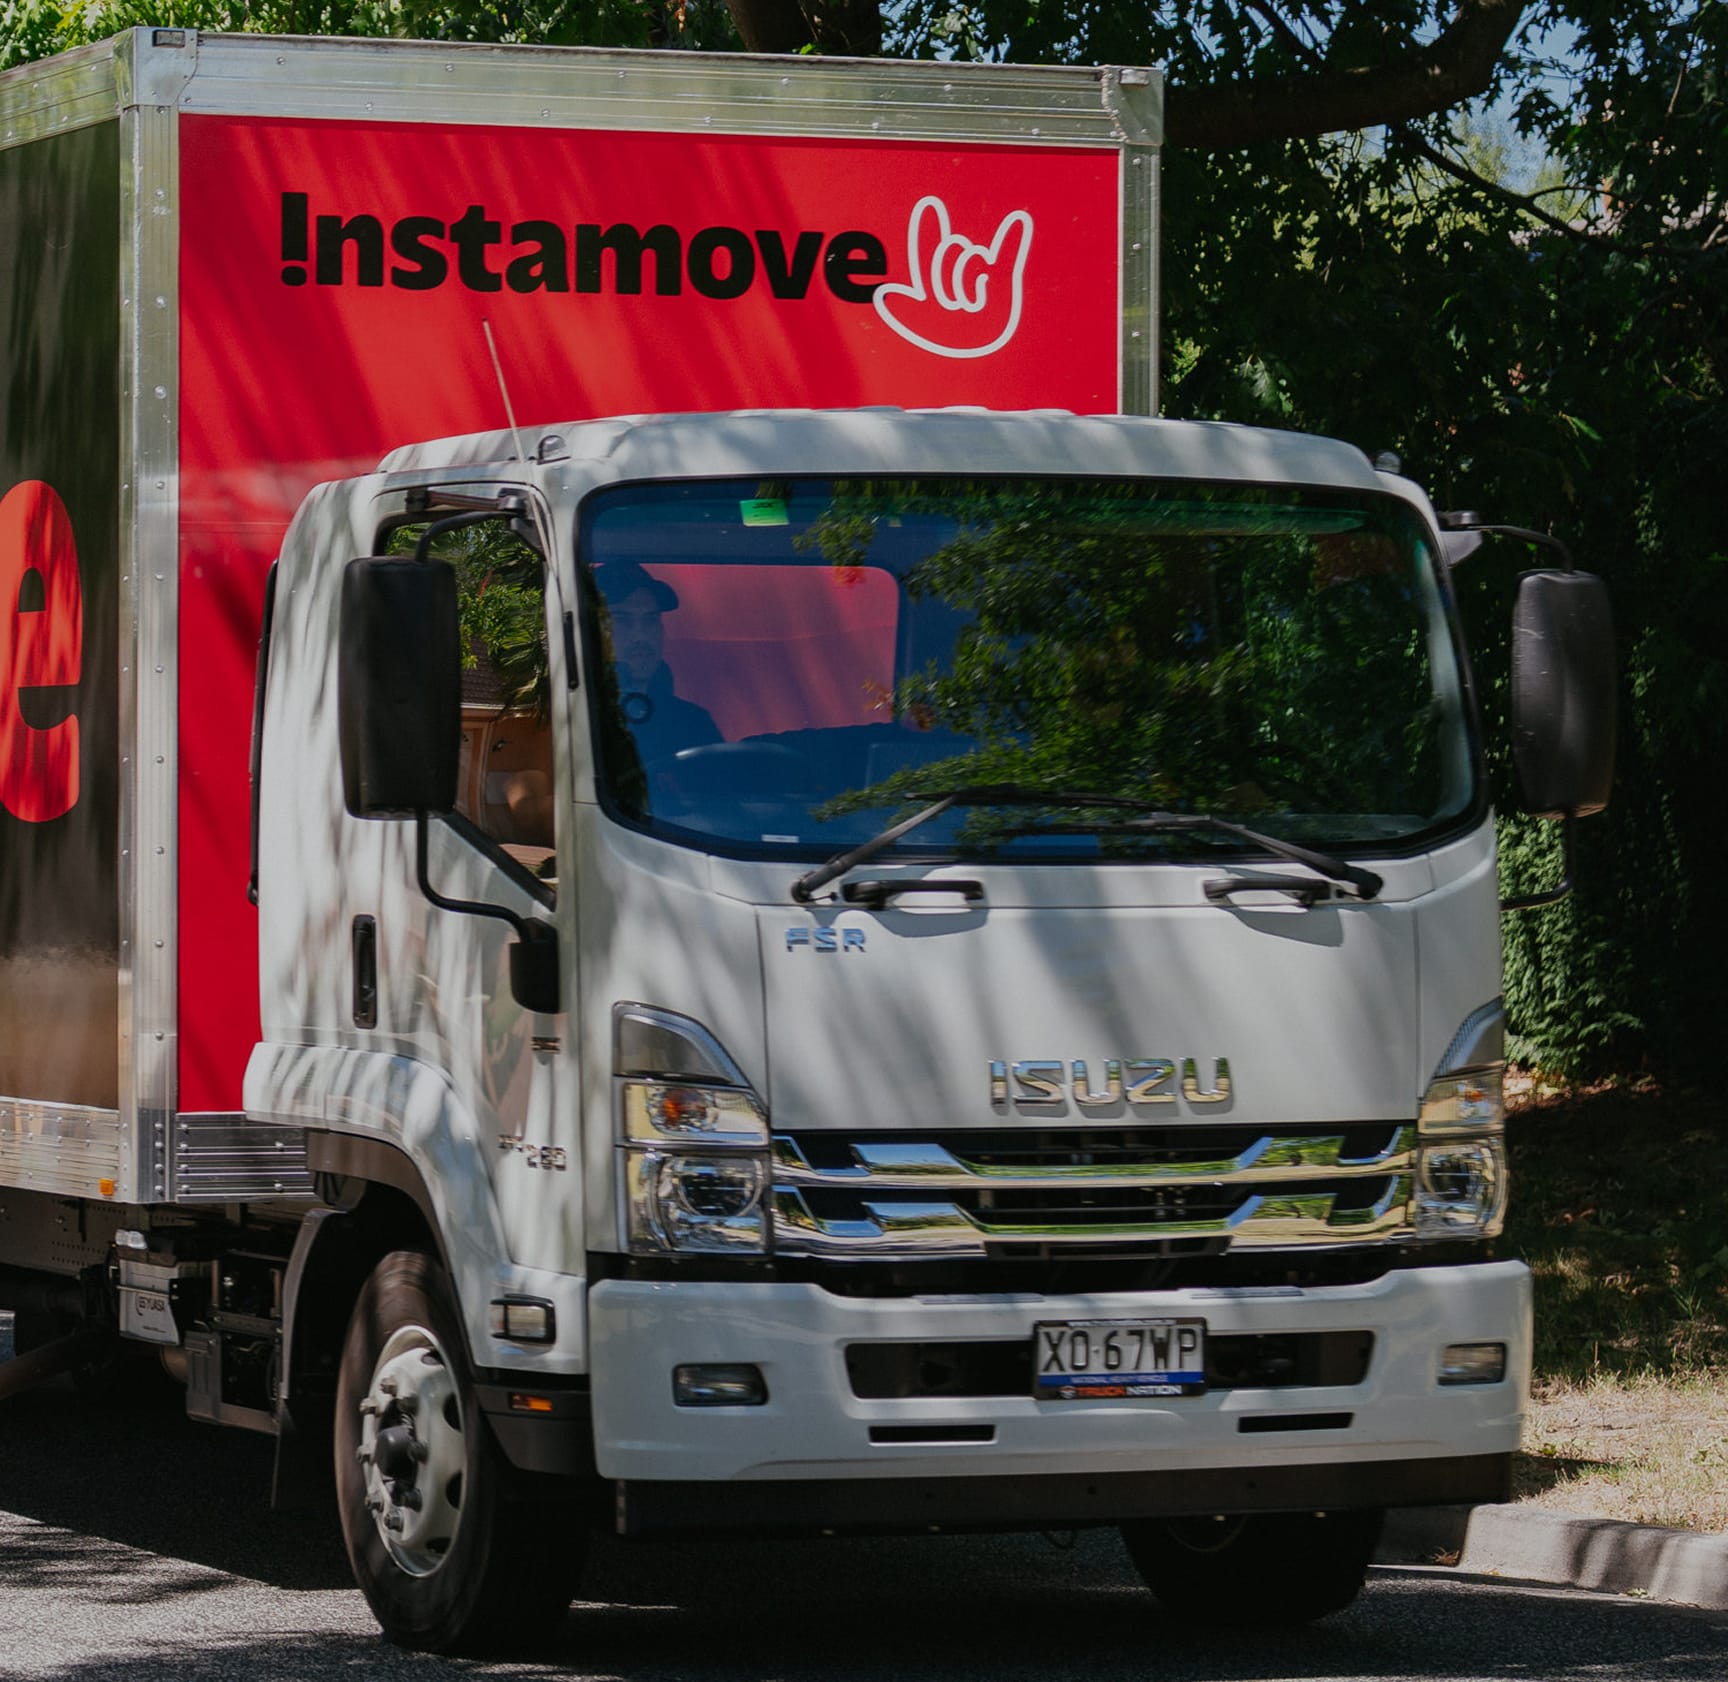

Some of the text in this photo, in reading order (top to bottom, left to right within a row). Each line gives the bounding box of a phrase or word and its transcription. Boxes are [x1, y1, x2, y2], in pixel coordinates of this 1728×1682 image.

[784, 926, 866, 952] FSR
[988, 1056, 1232, 1105] ISUZU
[1126, 1385, 1183, 1395] NATION
